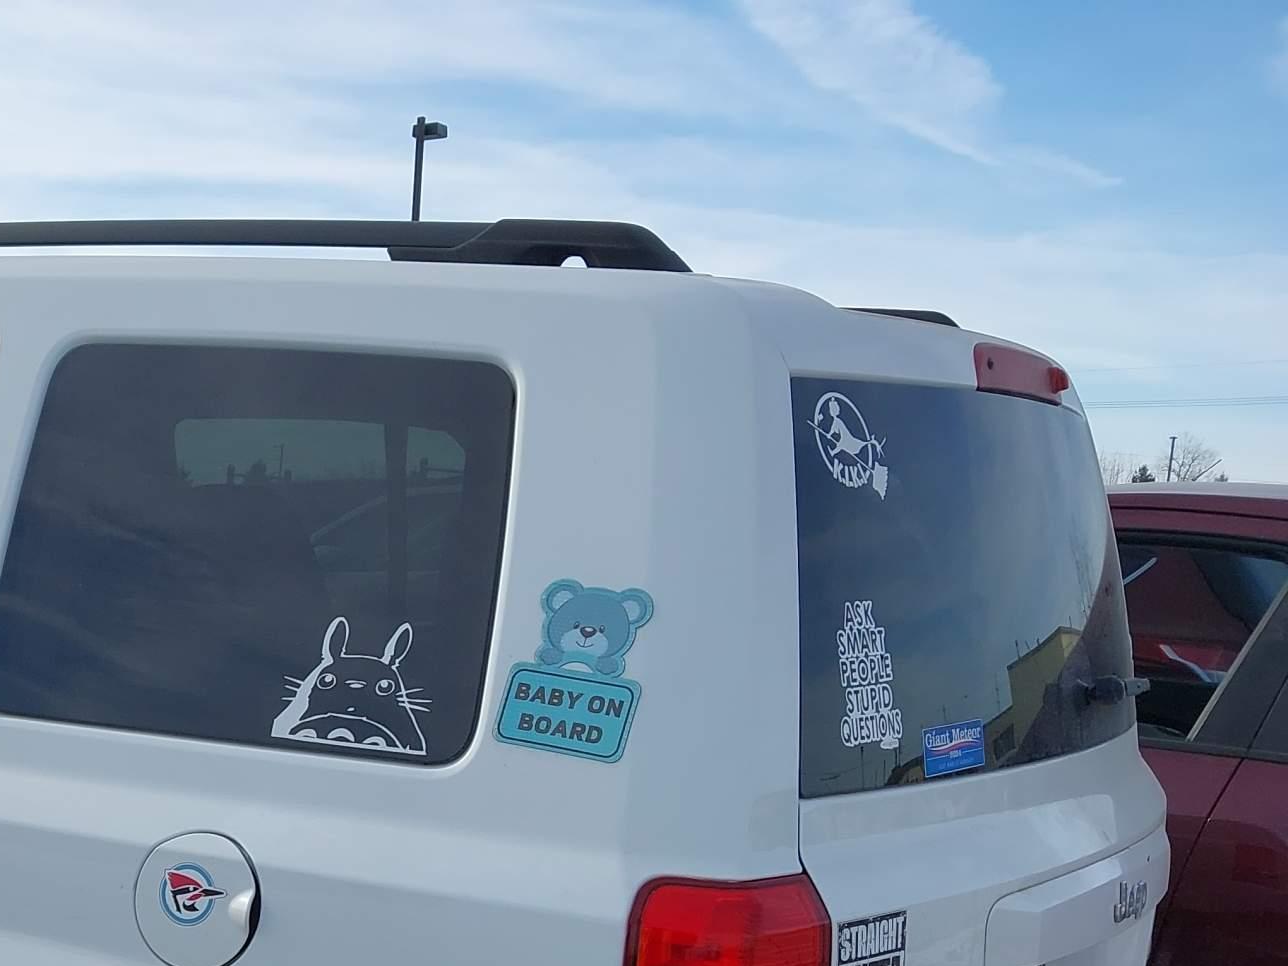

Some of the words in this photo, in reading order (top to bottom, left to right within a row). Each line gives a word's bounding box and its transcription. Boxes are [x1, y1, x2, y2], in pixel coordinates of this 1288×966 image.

[844, 601, 875, 629] ASK
[837, 629, 885, 657] SMART
[840, 655, 893, 685] PEOPLE
[514, 682, 584, 709] BABY
[587, 694, 626, 718] ON
[846, 685, 893, 714] STUPID
[517, 712, 604, 744] BOARD
[841, 711, 902, 746] QUESTIONS
[925, 730, 951, 748] Giant
[951, 727, 981, 744] Meteor
[1114, 880, 1148, 923] Jeep
[840, 915, 904, 962] STRAIGHT
